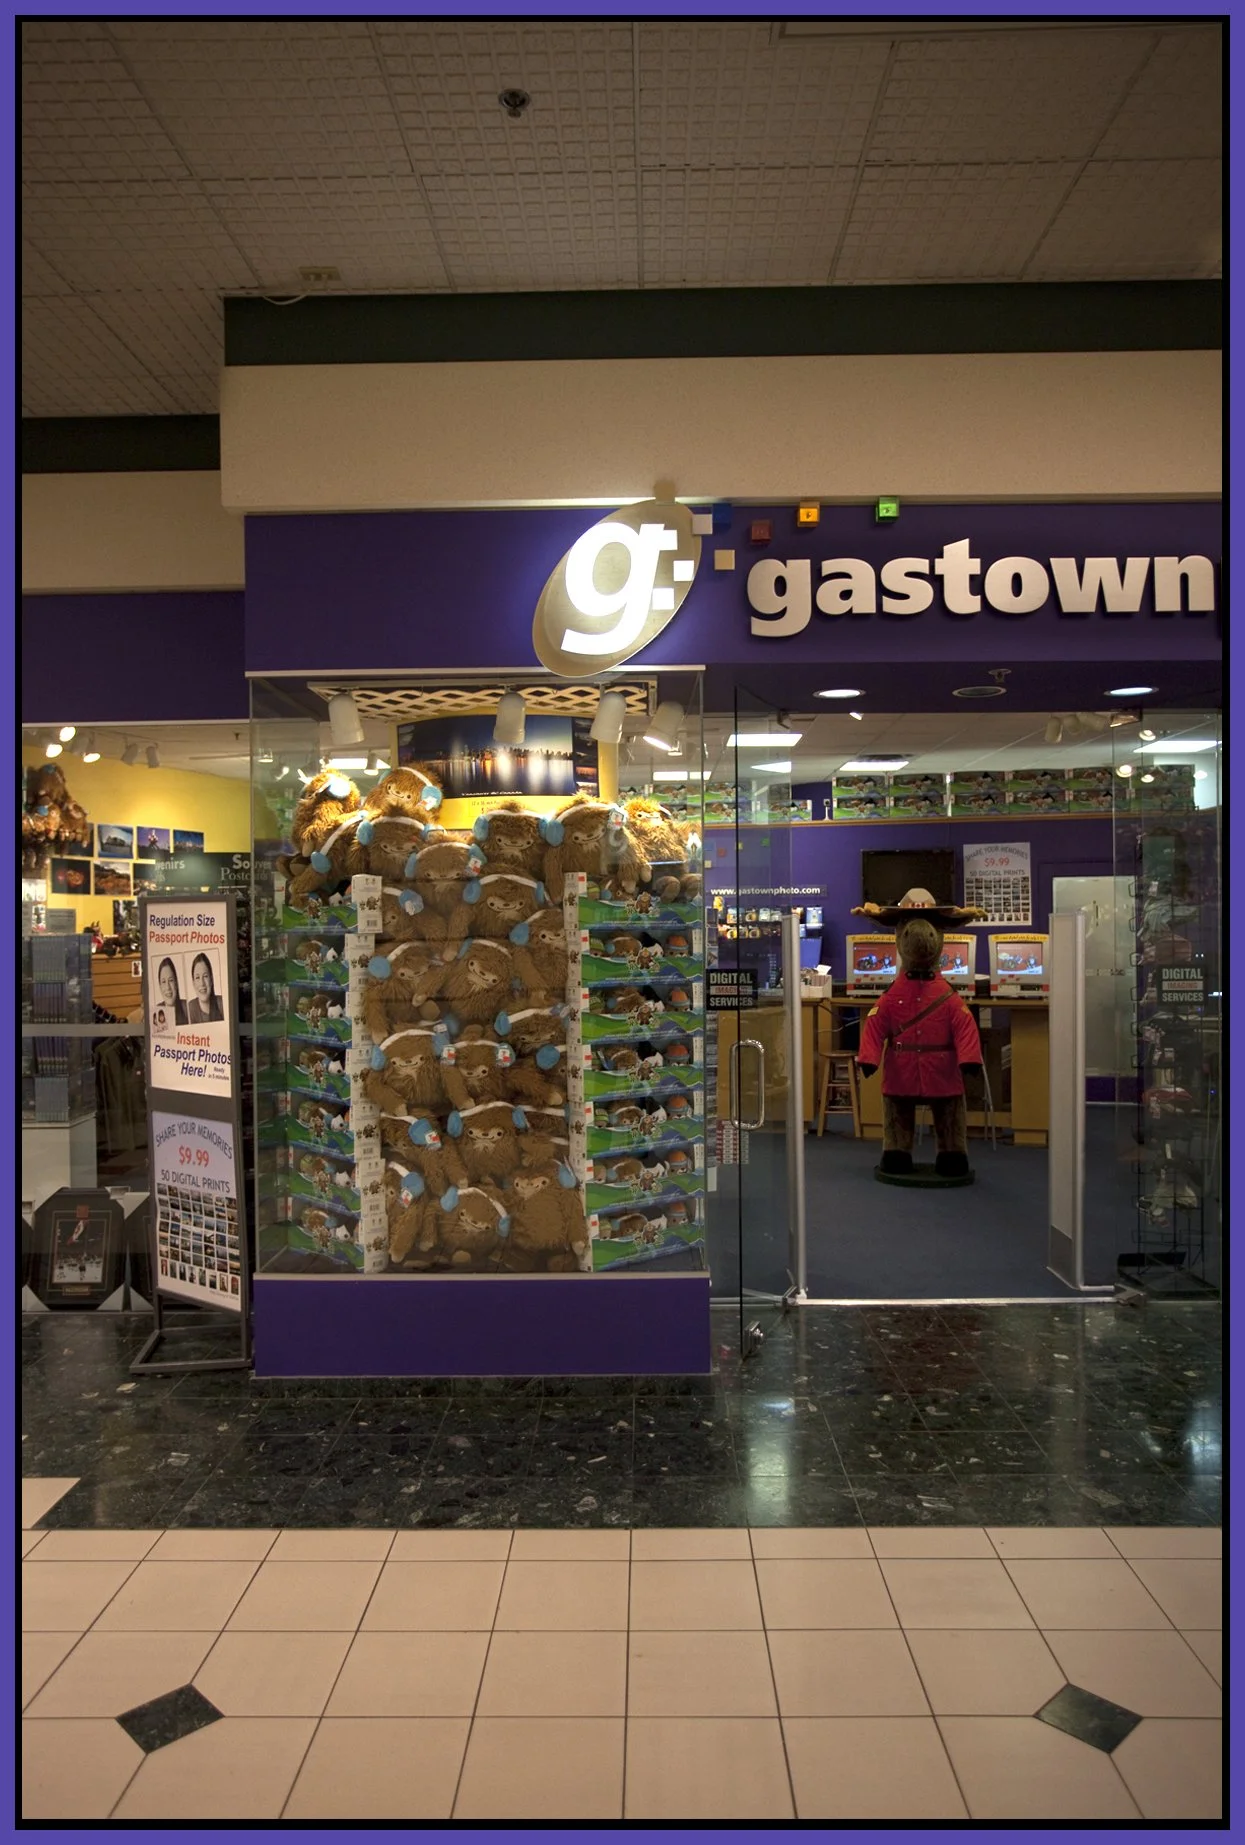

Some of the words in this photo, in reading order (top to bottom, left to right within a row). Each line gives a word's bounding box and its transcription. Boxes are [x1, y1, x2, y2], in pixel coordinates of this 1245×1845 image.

[747, 537, 1215, 637] gastown
[149, 914, 194, 929] Regulation
[196, 913, 215, 926] Size
[149, 931, 189, 945] Passport
[190, 931, 225, 944] Photos
[710, 972, 753, 984] DIGITAL
[1162, 968, 1203, 979] DIGITAL
[710, 997, 753, 1006] SERVICES
[1162, 992, 1204, 1002] SERVICES
[177, 1032, 210, 1047] Instant
[154, 1044, 195, 1063] Passport
[197, 1049, 231, 1065] Photos
[181, 1062, 207, 1077] Here!
[156, 1124, 177, 1147] SHARE
[177, 1122, 197, 1136] YOUR
[197, 1126, 233, 1160] MEMORIES
[178, 1146, 210, 1168] $9.99
[161, 1169, 170, 1182] 50
[172, 1171, 201, 1188] DIGITAL
[202, 1178, 231, 1193] PRINTS
